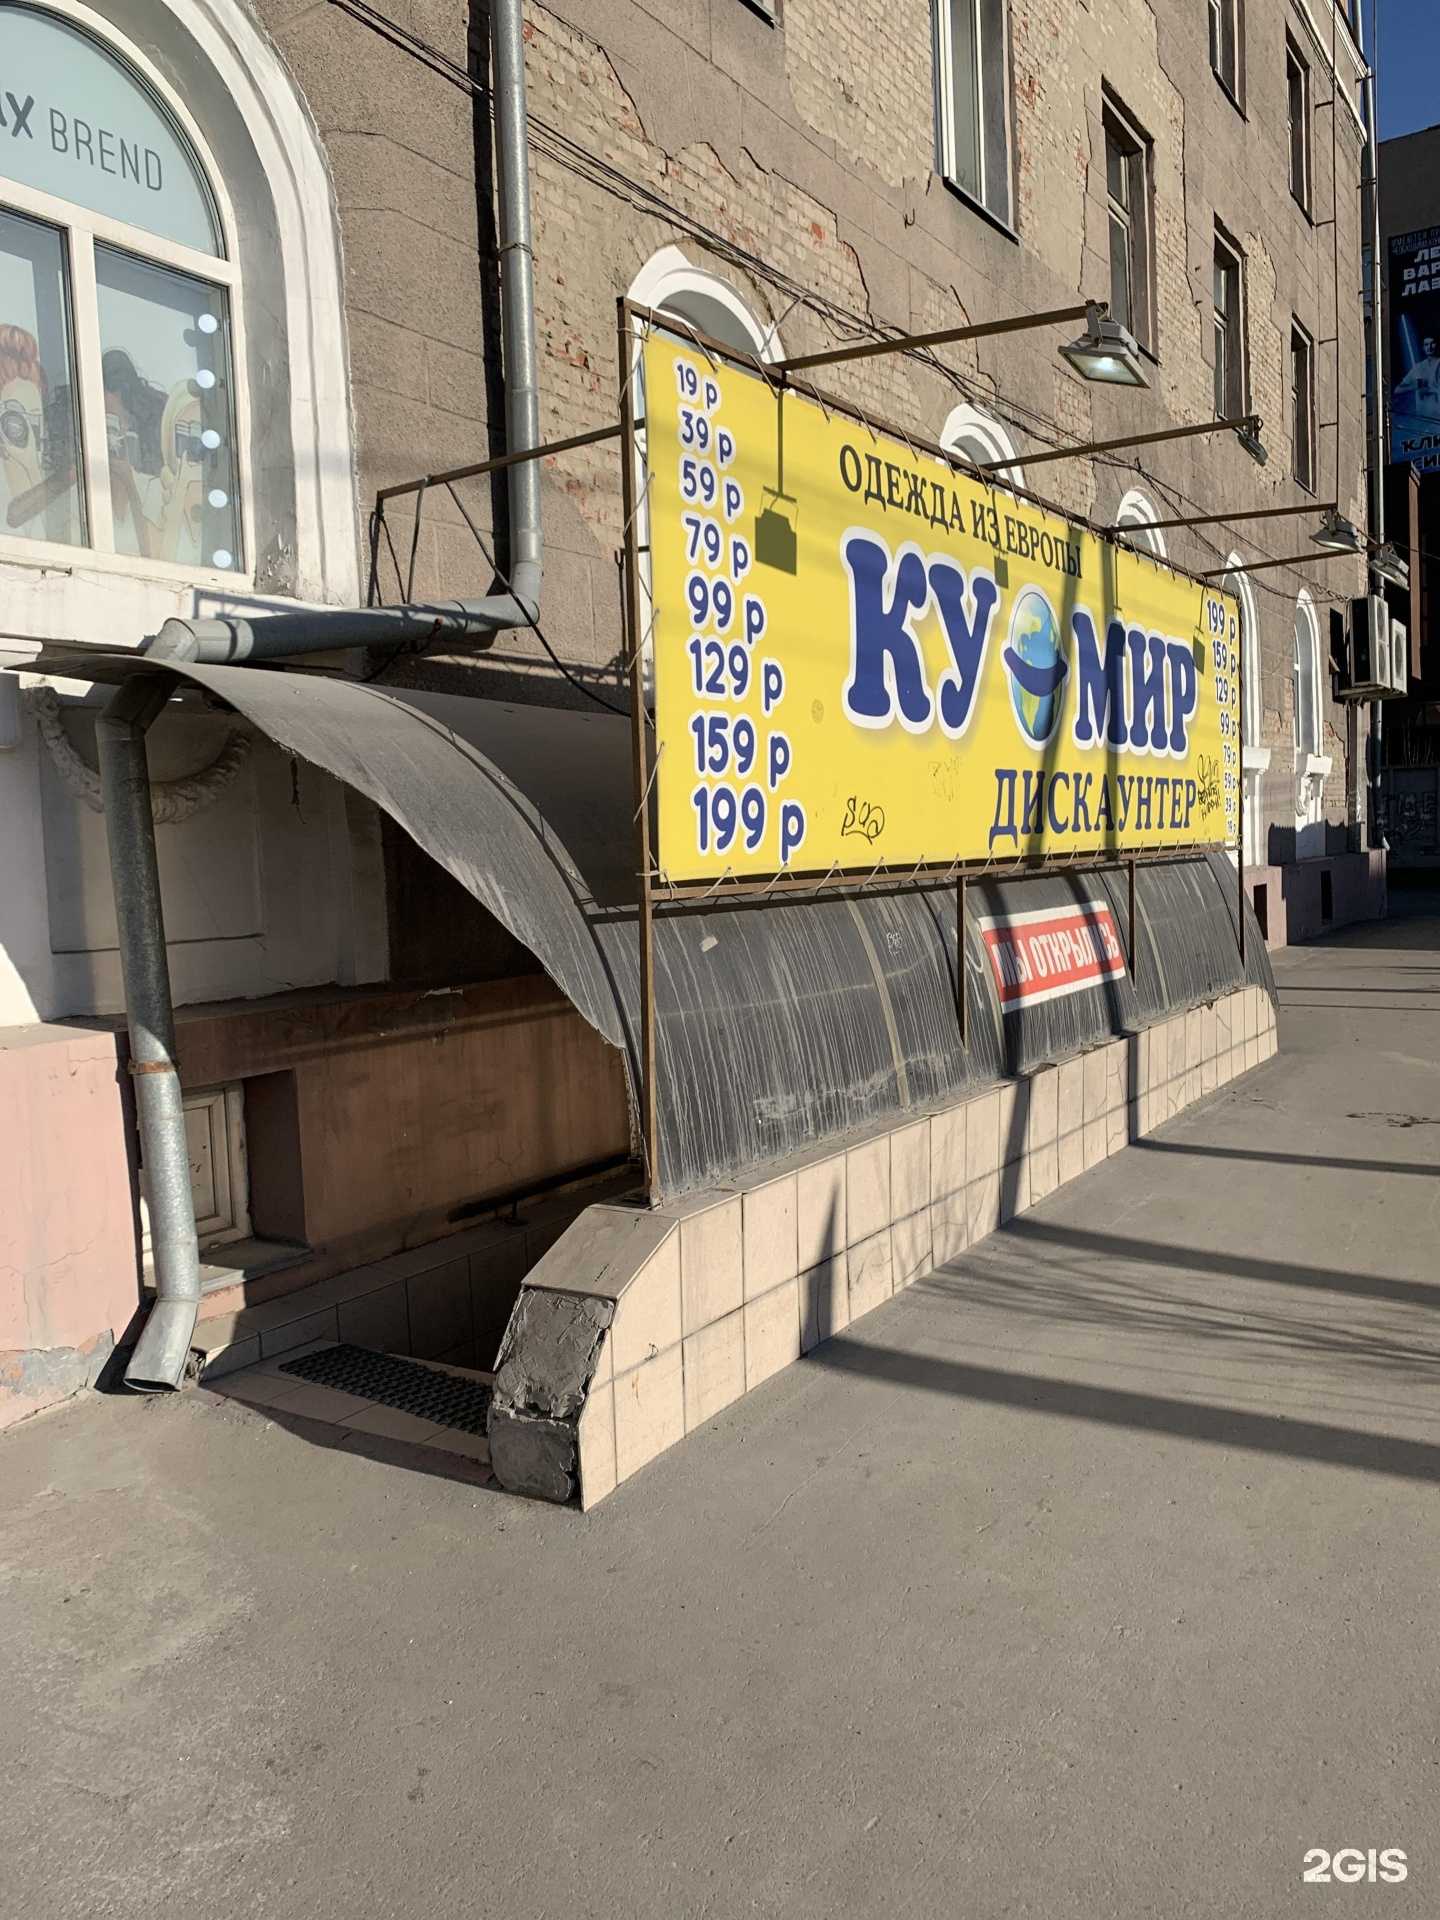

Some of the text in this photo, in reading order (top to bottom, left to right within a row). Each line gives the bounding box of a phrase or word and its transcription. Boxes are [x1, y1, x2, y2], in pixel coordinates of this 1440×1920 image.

[49, 107, 162, 191] BREND
[676, 363, 698, 396] 19
[681, 410, 709, 449] 39
[682, 459, 715, 502] 59
[839, 444, 1083, 579] ОДЕЖДА ИЗ ЕВРОПЫ
[685, 517, 720, 563] 79
[688, 576, 731, 628] 99
[1207, 600, 1226, 635] 199
[689, 639, 749, 696] 129
[1213, 640, 1228, 670] 159
[1216, 677, 1229, 703] 129
[691, 714, 755, 774] 159
[1220, 712, 1230, 735] 99
[693, 787, 766, 850] 199
[988, 768, 1197, 850] ДИСКАУНТЕР
[990, 922, 1121, 988] МЫ ОТКРЫЛИСЬ
